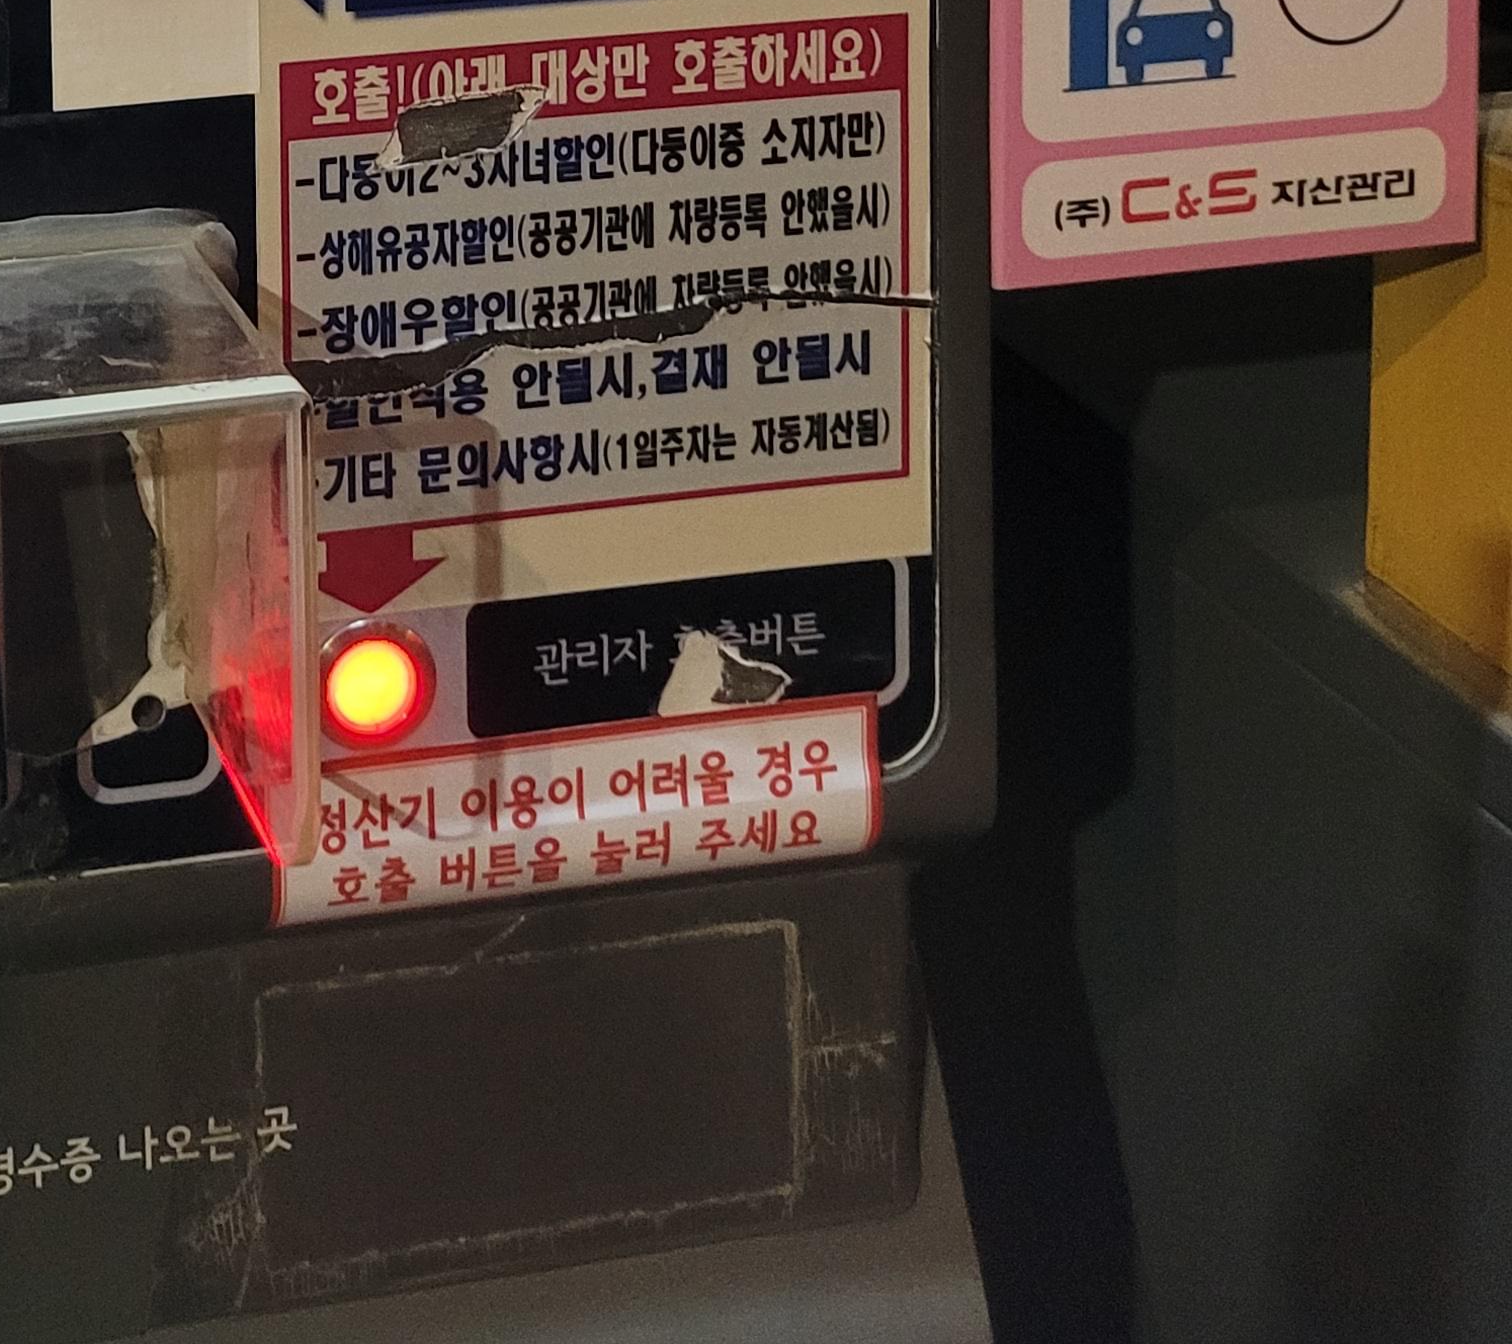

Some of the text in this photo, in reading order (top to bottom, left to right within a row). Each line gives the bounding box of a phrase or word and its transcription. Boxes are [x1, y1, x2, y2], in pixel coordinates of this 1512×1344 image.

[672, 27, 882, 94] 호출하세요)
[669, 192, 766, 244] 차량등록
[1055, 168, 1415, 232] (주) 자산관리
[752, 329, 871, 386] 안될시
[323, 450, 396, 503] 기타
[532, 630, 653, 686] 관리자
[319, 738, 840, 856] 정산기 이용이 어려울 경우
[329, 808, 823, 909] 호출 버튼을 눌러 주세요
[115, 1117, 242, 1172] 나오는
[255, 1105, 298, 1156] 곳
